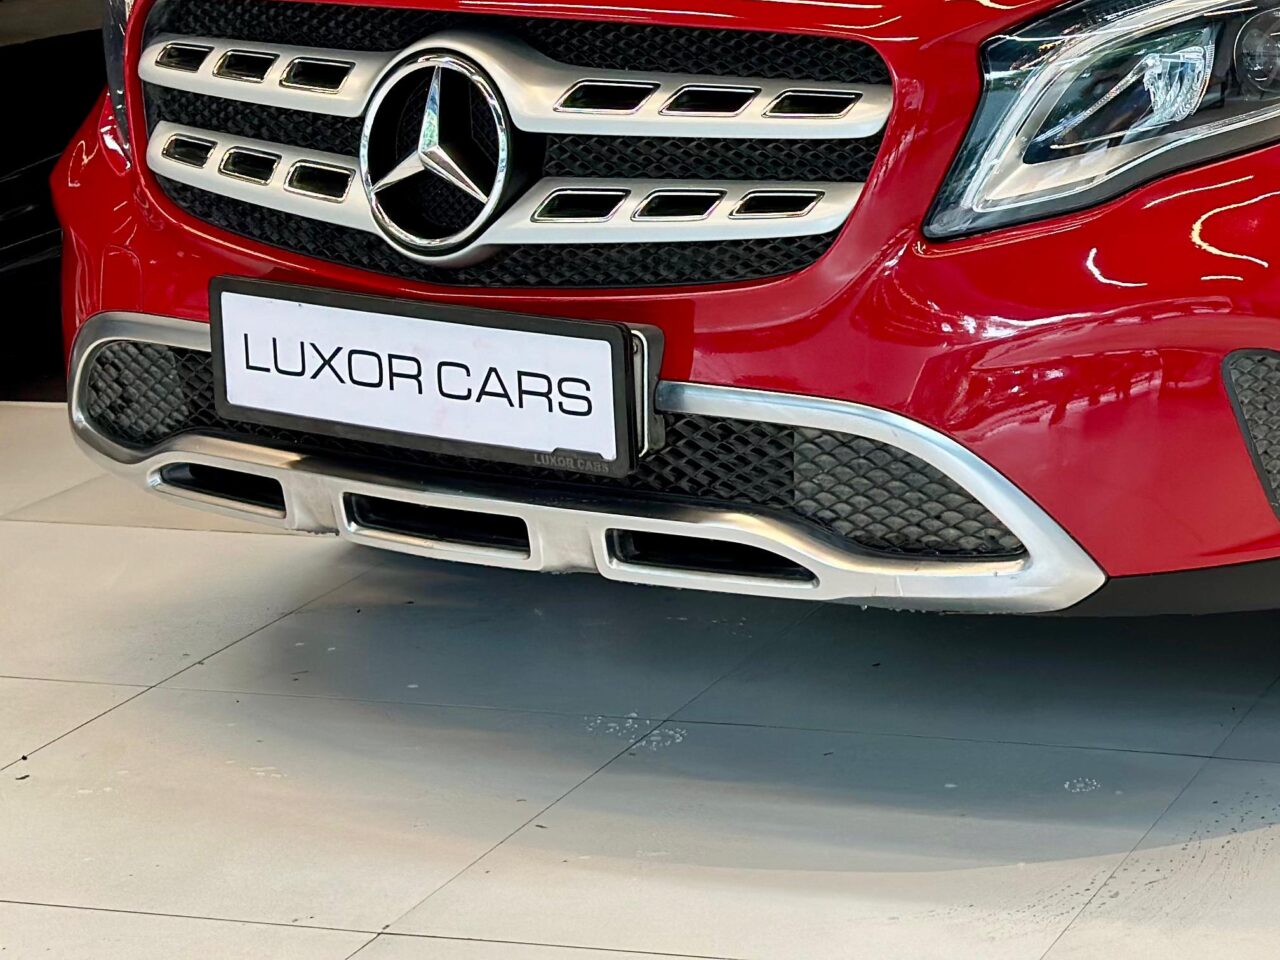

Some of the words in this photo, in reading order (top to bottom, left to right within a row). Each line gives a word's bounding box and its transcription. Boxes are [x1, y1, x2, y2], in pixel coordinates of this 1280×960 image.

[243, 332, 423, 395] LUXOR
[436, 360, 593, 417] CARS
[534, 454, 575, 469] LUXOR
[577, 459, 609, 473] CARS
